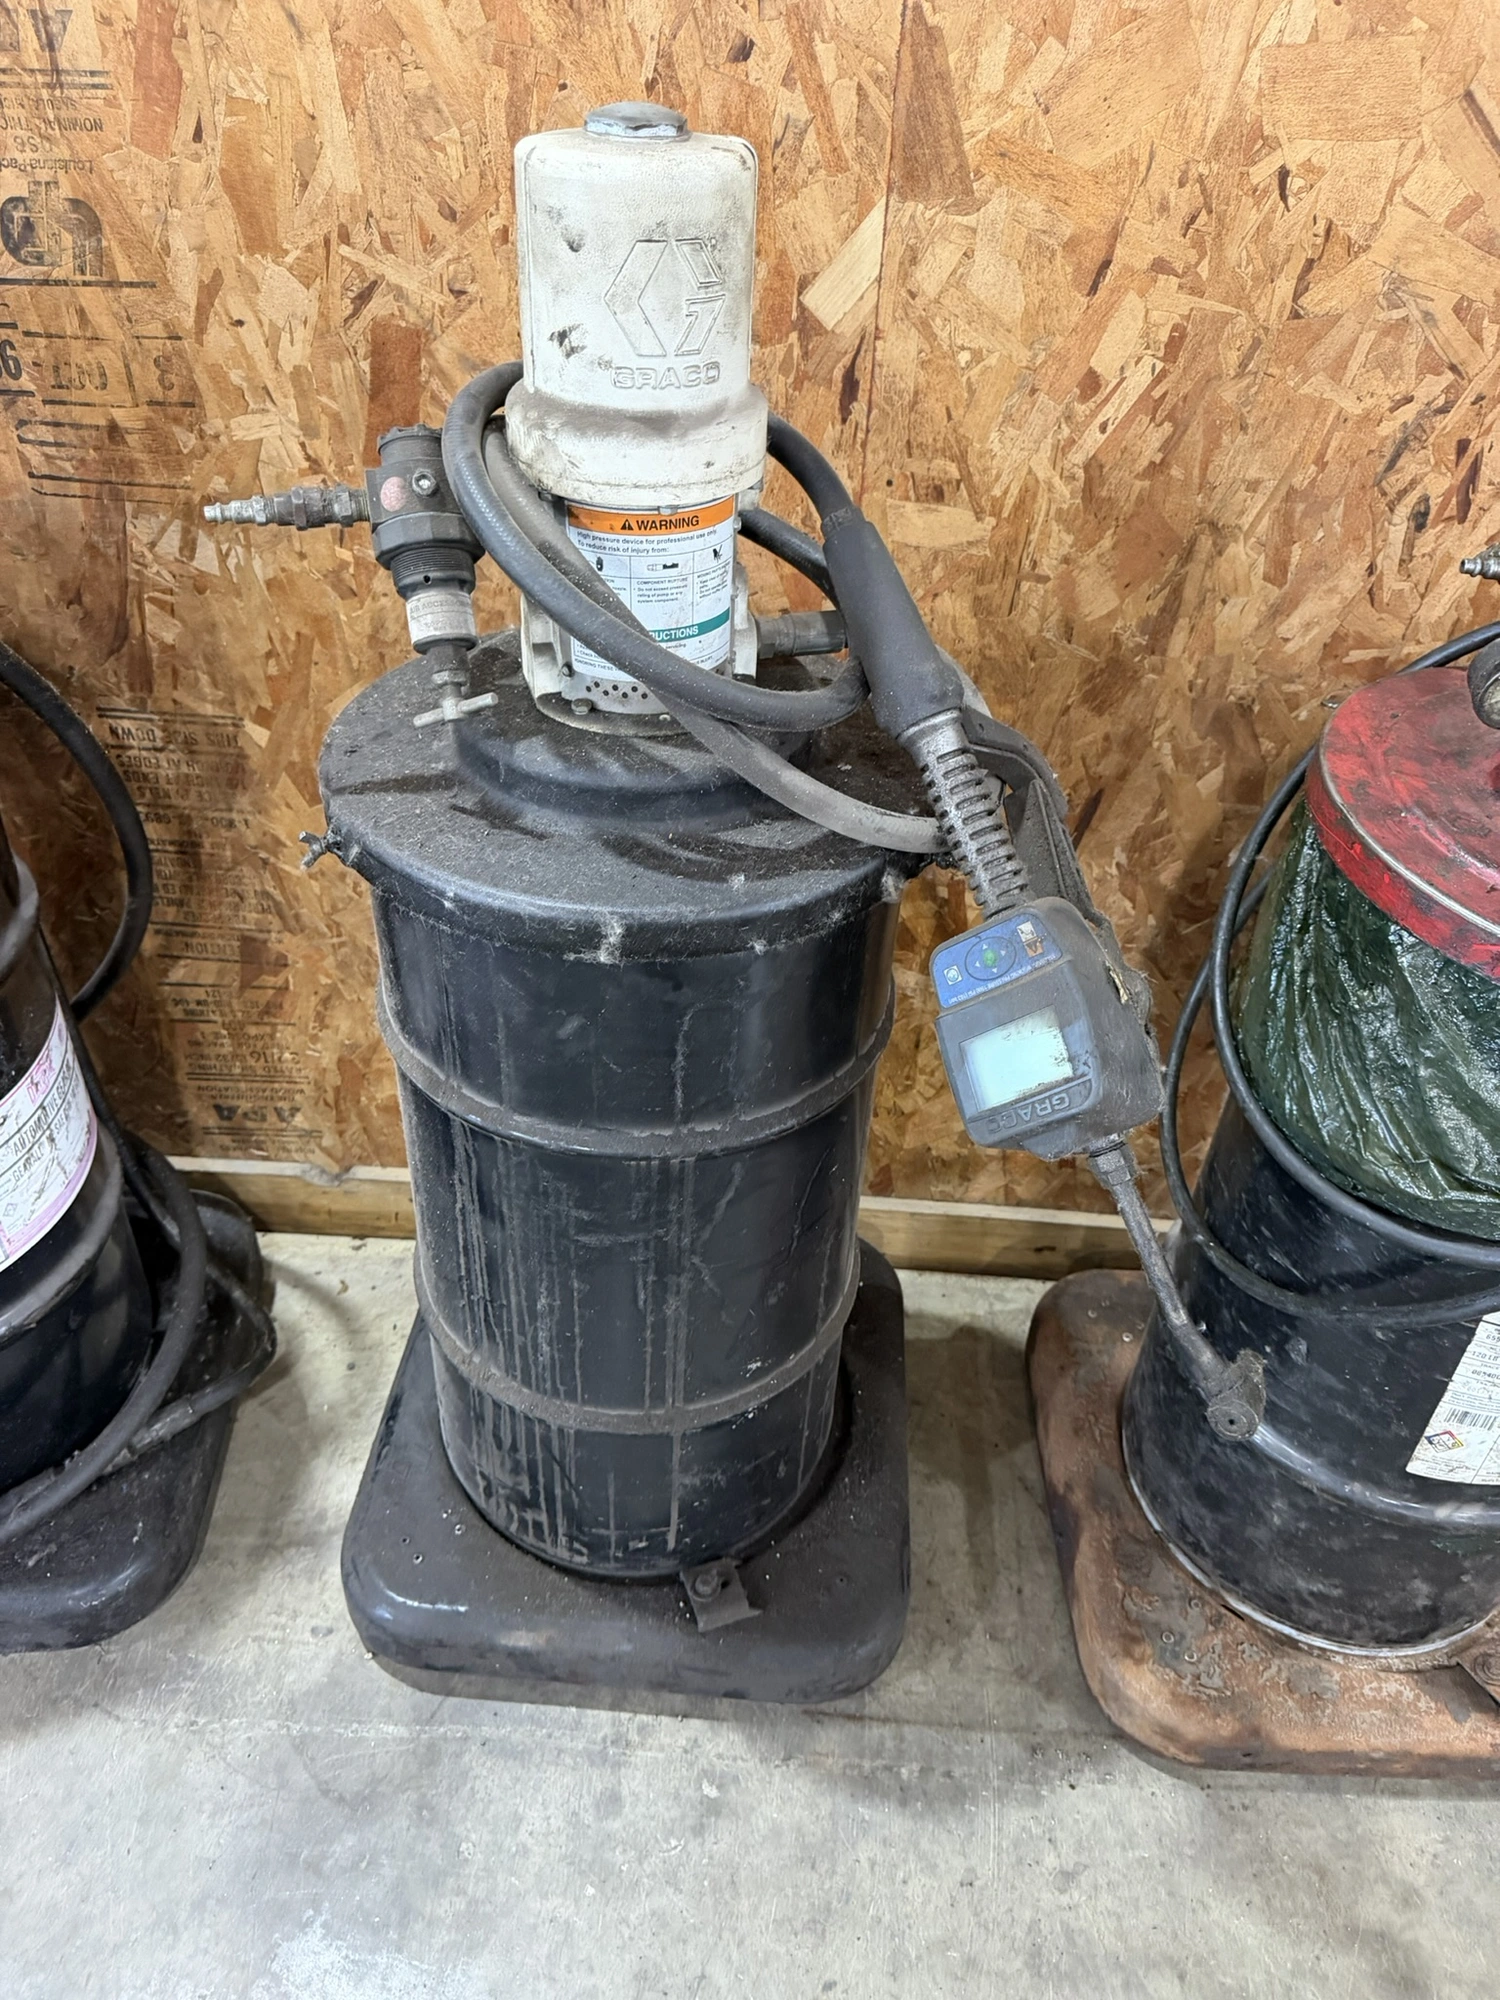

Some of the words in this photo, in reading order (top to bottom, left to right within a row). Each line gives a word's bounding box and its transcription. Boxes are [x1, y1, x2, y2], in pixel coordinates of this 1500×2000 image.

[610, 361, 721, 390] GRACO
[636, 515, 700, 531] WARNING
[576, 531, 590, 540] High
[592, 534, 620, 544] pressure
[621, 537, 644, 545] device
[656, 534, 695, 545] professional
[695, 532, 706, 540] use
[586, 541, 607, 550] reduce
[608, 545, 620, 553] risk
[630, 546, 650, 555] injury
[649, 626, 699, 640] RUCTIONS
[108, 724, 157, 743] DOWN
[115, 754, 160, 768] EDGES
[123, 769, 159, 784] ENDS
[987, 1093, 1070, 1133] GRACO
[13, 1092, 59, 1157] AUTOMOTIVE
